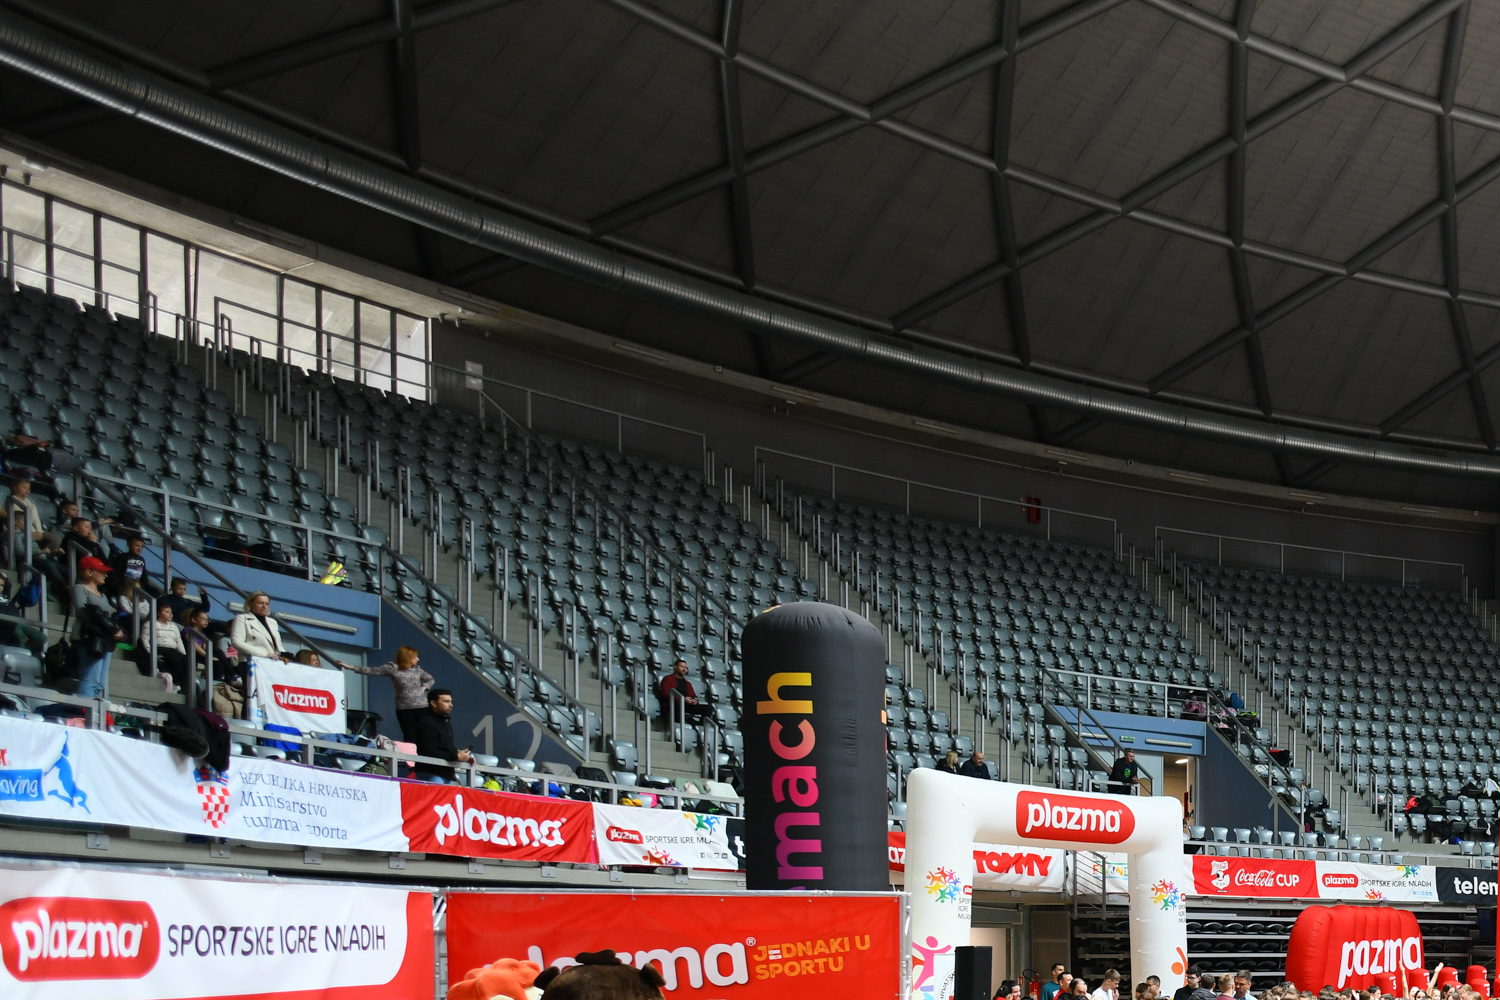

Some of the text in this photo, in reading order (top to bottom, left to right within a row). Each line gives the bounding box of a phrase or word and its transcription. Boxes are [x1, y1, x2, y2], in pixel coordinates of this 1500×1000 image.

[756, 671, 824, 880] mach
[308, 782, 368, 803] HRVATSKA
[433, 793, 566, 848] plazma
[1025, 797, 1121, 834] plazma
[645, 834, 679, 845] SPORTSKE
[681, 835, 696, 845] IGRE
[973, 850, 1052, 877] TOMMY
[1235, 868, 1300, 888] Coca-Cola CUP
[1325, 874, 1432, 888] plazma SPORTSKE IGRE MLADIH
[12, 909, 387, 973] plazma SPORTSKE IGRE MLADIH
[752, 934, 872, 962] JEDNAKI U
[755, 956, 844, 980] SPORTU
